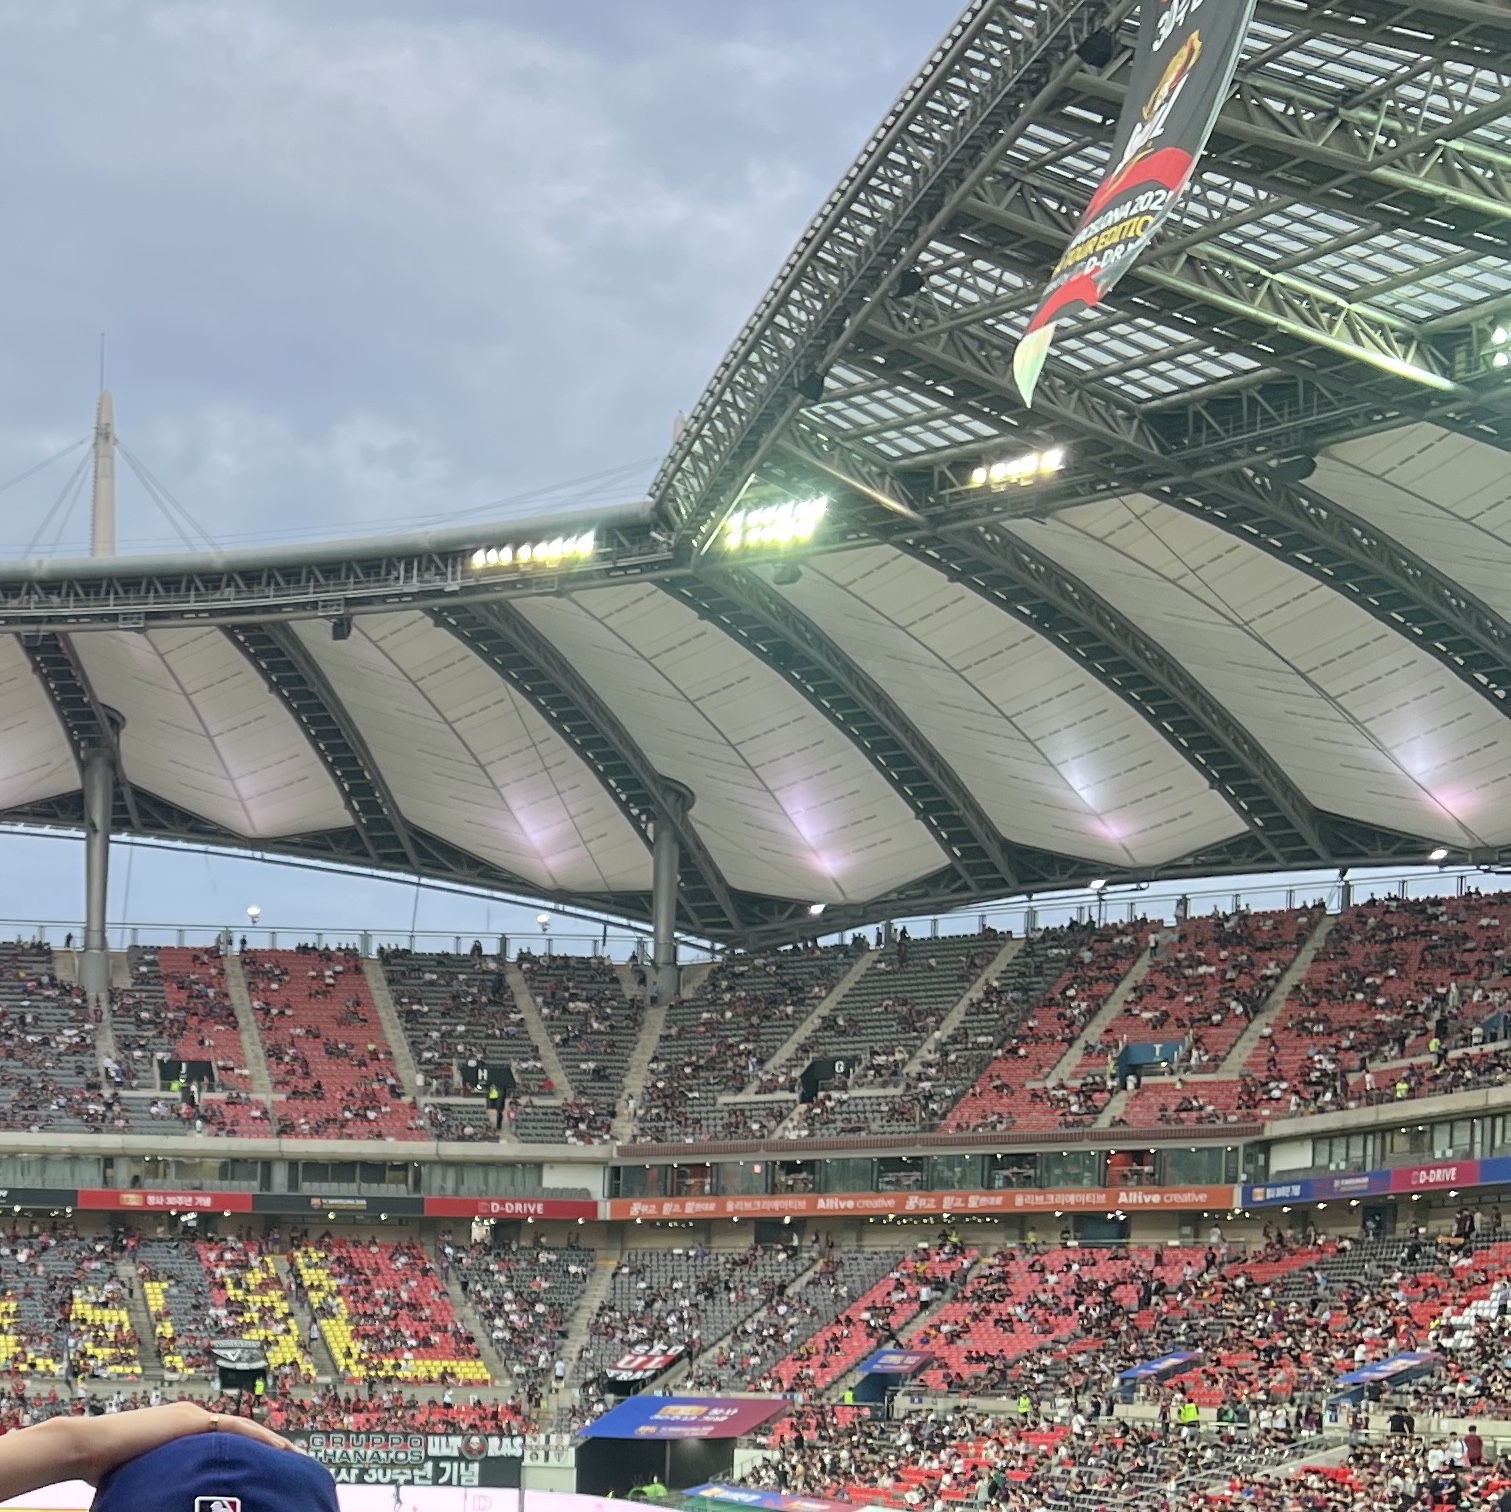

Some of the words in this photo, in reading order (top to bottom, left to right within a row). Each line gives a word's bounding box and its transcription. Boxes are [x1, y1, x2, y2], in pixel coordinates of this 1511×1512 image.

[1419, 1167, 1457, 1184] D-DRIVE
[856, 1198, 896, 1208] creative
[1163, 1192, 1208, 1203] creative
[491, 1202, 544, 1215] D-DRIVE
[310, 1434, 425, 1449] GRUPPO
[311, 1449, 425, 1464] THANATOS
[363, 1462, 433, 1486] 30주년
[438, 1461, 479, 1487] 기념
